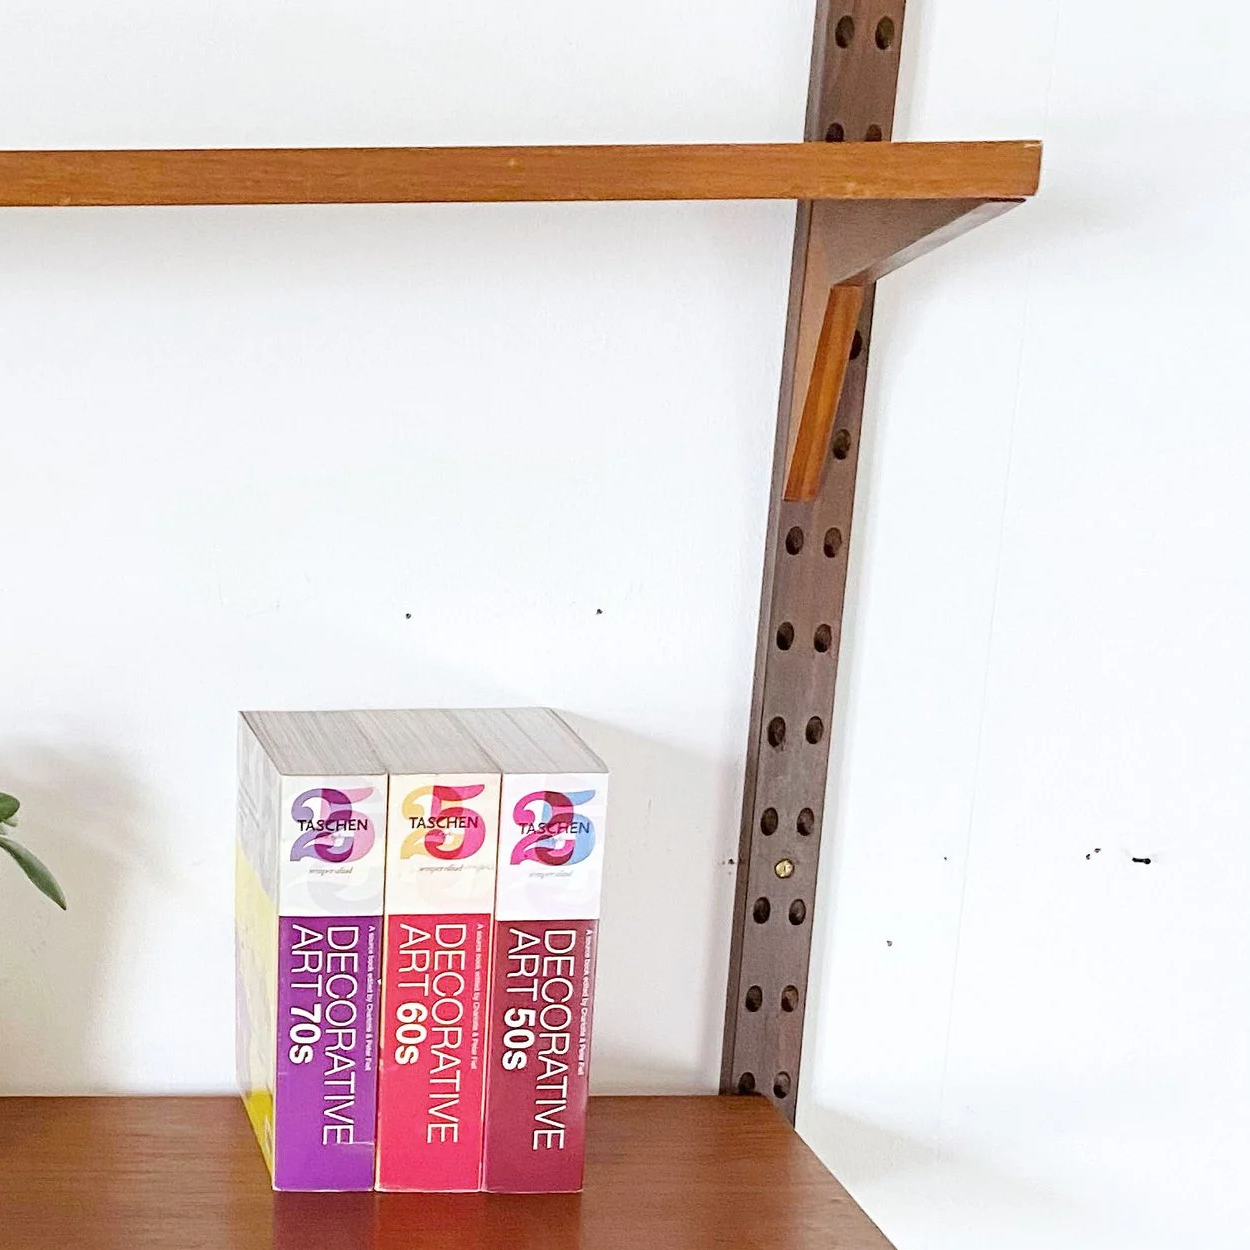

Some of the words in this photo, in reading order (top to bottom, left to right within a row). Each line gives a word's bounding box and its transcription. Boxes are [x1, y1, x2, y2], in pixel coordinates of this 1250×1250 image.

[298, 818, 368, 832] TASCHEN
[408, 816, 479, 829] TASCHEN
[518, 821, 590, 834] TASCHEN
[291, 924, 323, 997] ART
[398, 923, 431, 996] ART
[506, 928, 541, 1002] ART
[289, 1003, 322, 1064] 70s
[323, 926, 359, 1145] DECORATIVE
[395, 1002, 429, 1065] 60s
[427, 924, 467, 1144] DECORATIVE
[502, 1008, 537, 1071] 50s
[532, 929, 576, 1150] DECORATIVE
